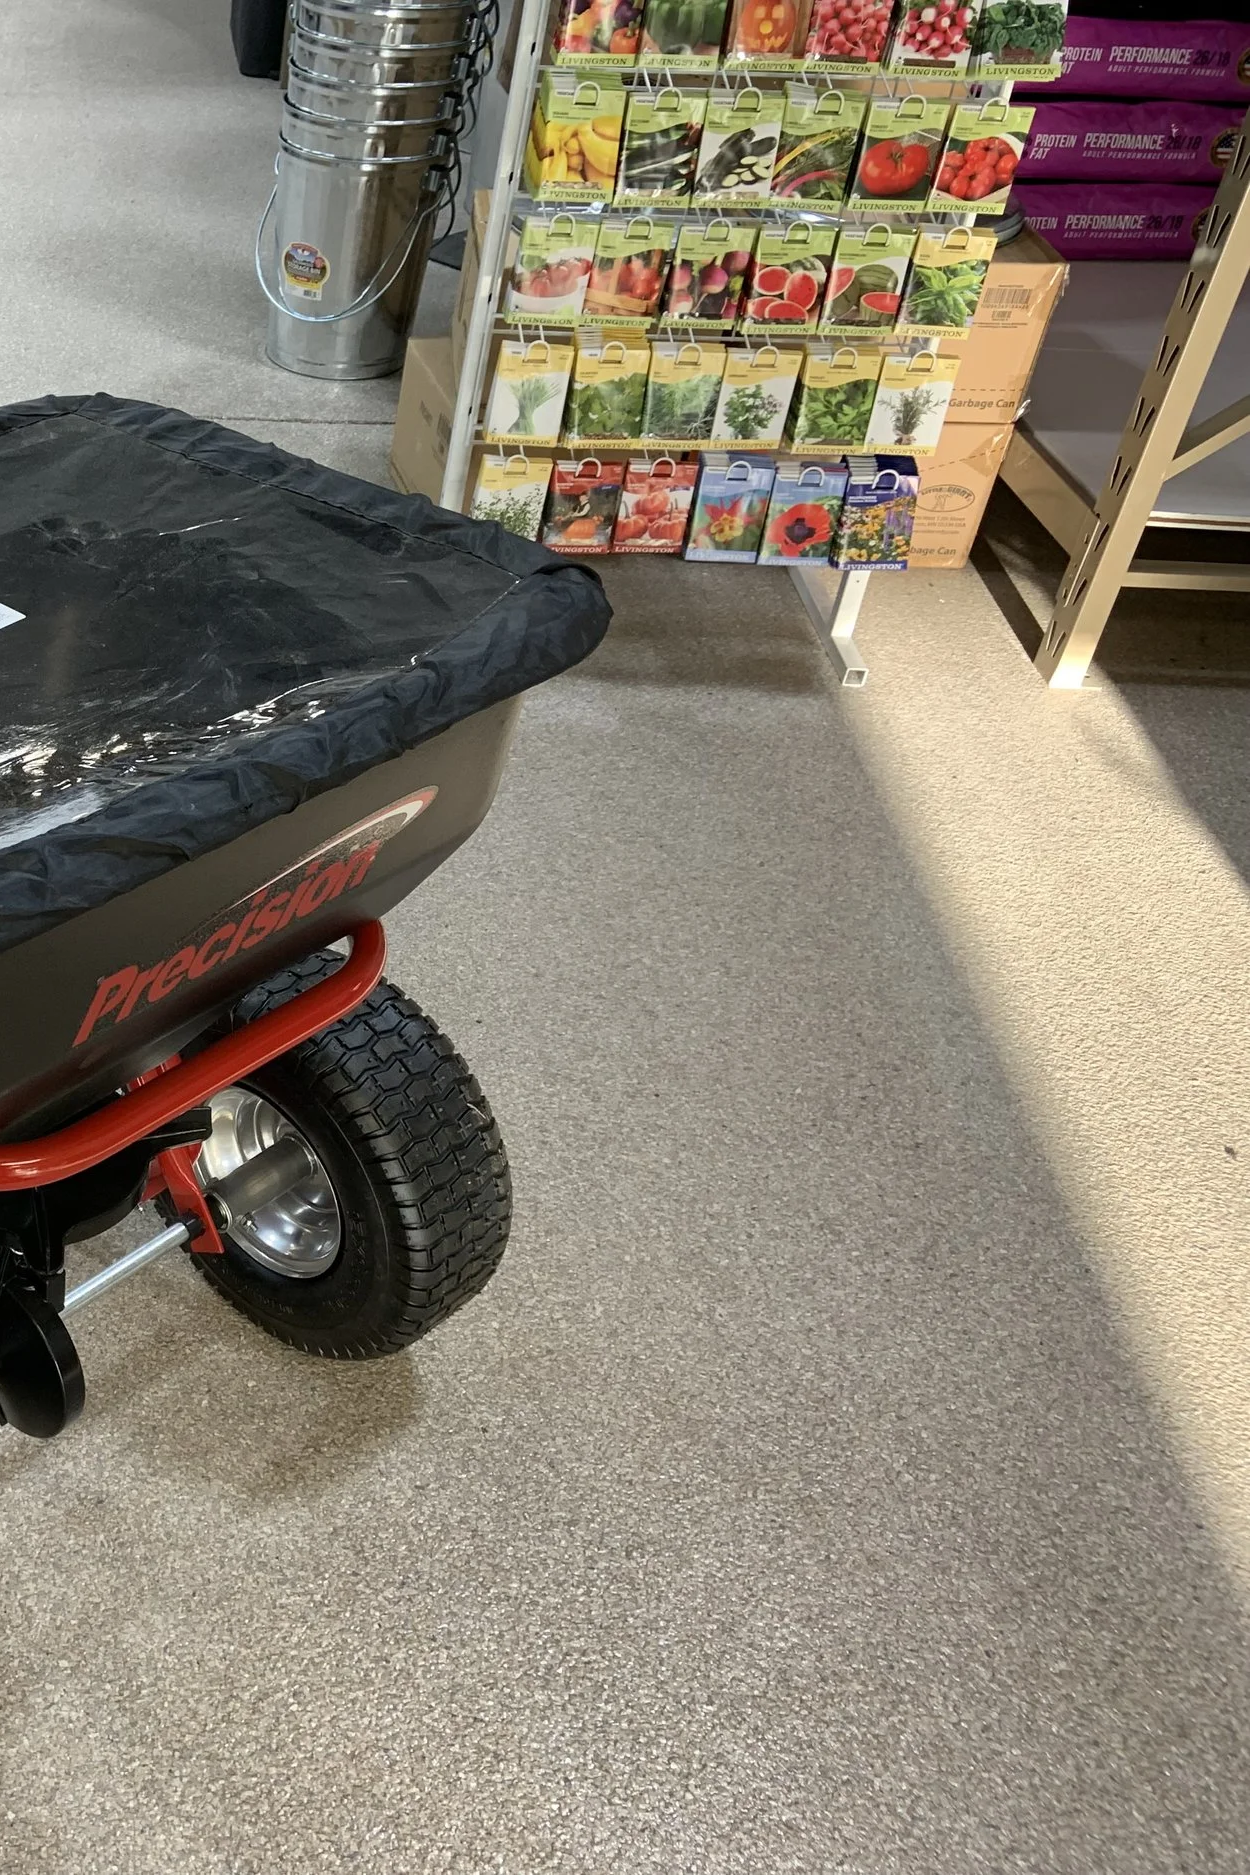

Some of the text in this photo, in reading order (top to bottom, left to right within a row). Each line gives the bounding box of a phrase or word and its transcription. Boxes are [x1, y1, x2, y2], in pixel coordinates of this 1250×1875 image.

[1108, 45, 1194, 65] PERFORMANCE
[561, 57, 628, 65] LIVINGSTON
[806, 64, 873, 73] LIVINGSTON
[893, 67, 961, 78] LIVINGSTON
[985, 67, 1056, 76] LIVINGSTON
[1061, 61, 1075, 75] AT
[1034, 133, 1078, 149] PROTEIN
[1083, 132, 1166, 150] PERFORMANCE
[1029, 148, 1051, 160] FAT
[852, 202, 918, 213] LIVINGSTON
[931, 203, 998, 214] LIVINGSTON
[1024, 216, 1059, 230] ROTEIN
[1064, 214, 1147, 230] PERFORMANCE
[511, 316, 574, 326] LIVINGSTON
[583, 317, 647, 327] LIVINGSTON
[663, 320, 727, 329] LIVINGSTON
[746, 325, 811, 334] LIVINGSTON
[949, 398, 1016, 410] Garbage Can
[491, 436, 551, 446] LIVINGSTON
[573, 441, 634, 449] LIVINGSTON
[713, 441, 774, 450] LIVINGSTON
[795, 446, 856, 455] LIVINGSTON
[615, 546, 675, 554] LIVINGSTON
[909, 546, 957, 557] bage Can
[839, 562, 904, 571] LIVINGSTON
[72, 840, 382, 1048] Precision
